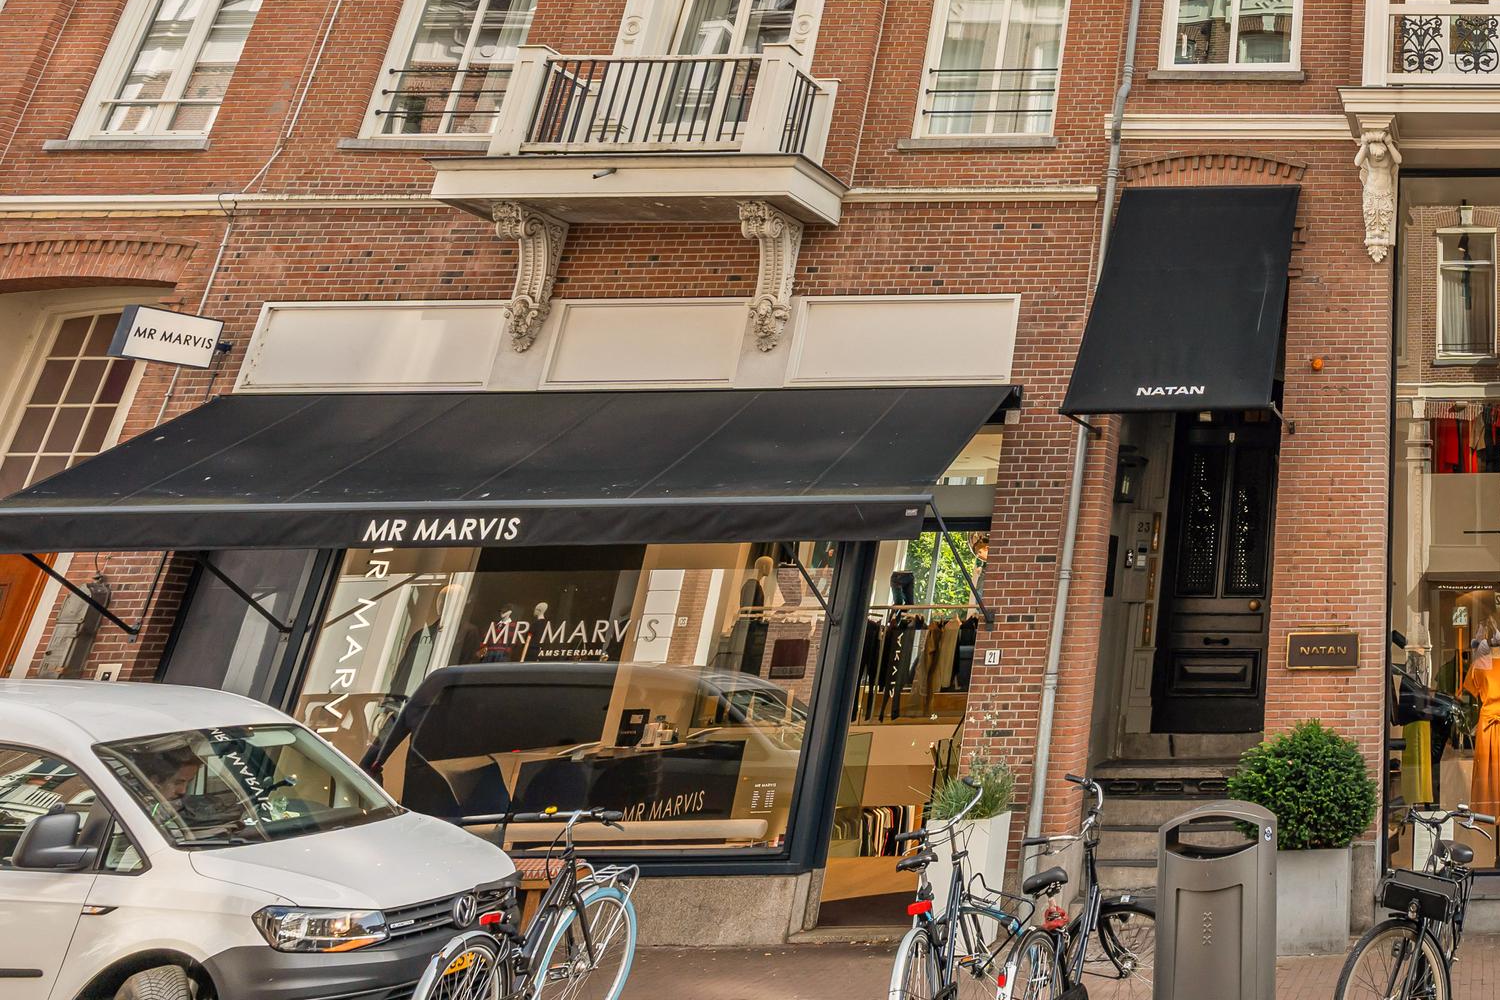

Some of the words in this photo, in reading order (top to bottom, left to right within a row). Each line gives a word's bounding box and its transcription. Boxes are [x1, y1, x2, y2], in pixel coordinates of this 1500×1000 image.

[133, 326, 157, 340] MR
[160, 330, 214, 350] MARVIS
[1136, 385, 1205, 396] NATAN
[362, 519, 408, 542] MR
[412, 517, 521, 541] MARVIS
[1137, 522, 1151, 533] 23
[365, 548, 394, 579] R
[483, 620, 530, 645] MR
[539, 618, 660, 644] MARVIS
[538, 649, 604, 658] AMSTERDAM
[987, 652, 996, 663] 21
[1300, 646, 1347, 655] NATAN
[316, 597, 377, 746] MARVI
[622, 802, 645, 822] MR
[648, 790, 705, 820] MARVIS
